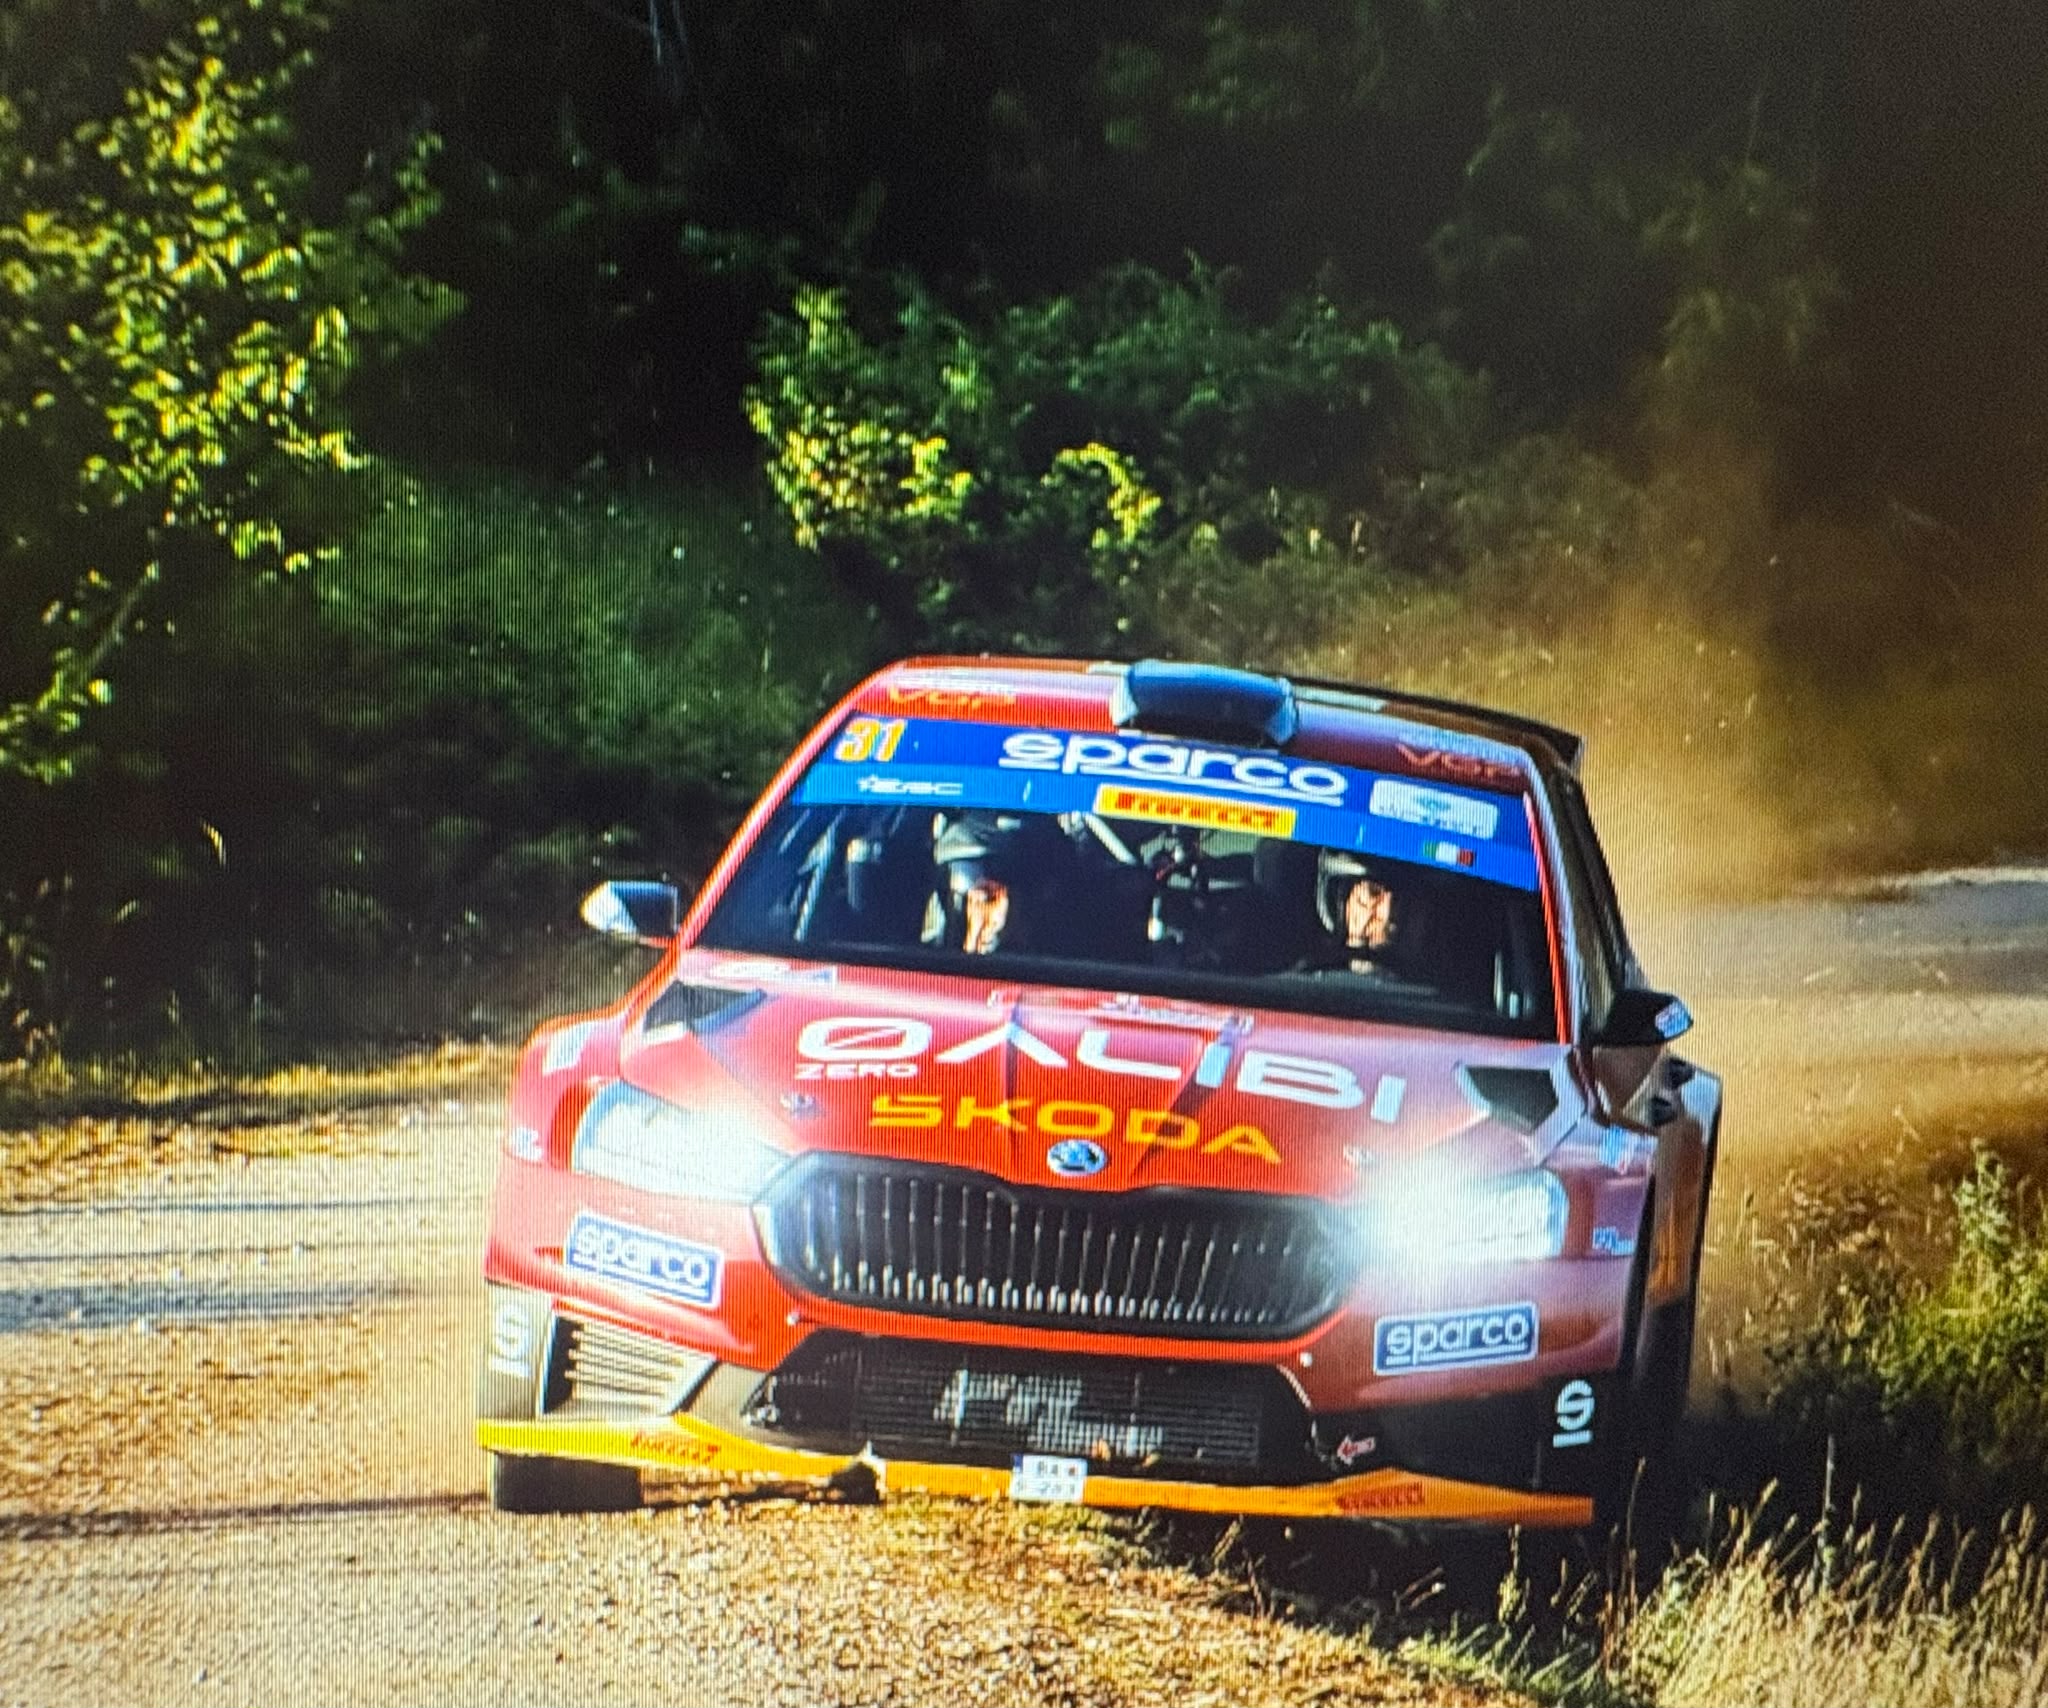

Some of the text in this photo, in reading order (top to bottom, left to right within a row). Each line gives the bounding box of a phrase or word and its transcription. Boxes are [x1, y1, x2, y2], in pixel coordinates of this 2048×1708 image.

[834, 718, 908, 762] 31
[999, 733, 1348, 807] sparco
[795, 1063, 919, 1081] ZERO
[572, 1222, 713, 1298] sparco
[1386, 1313, 1530, 1366] sparco
